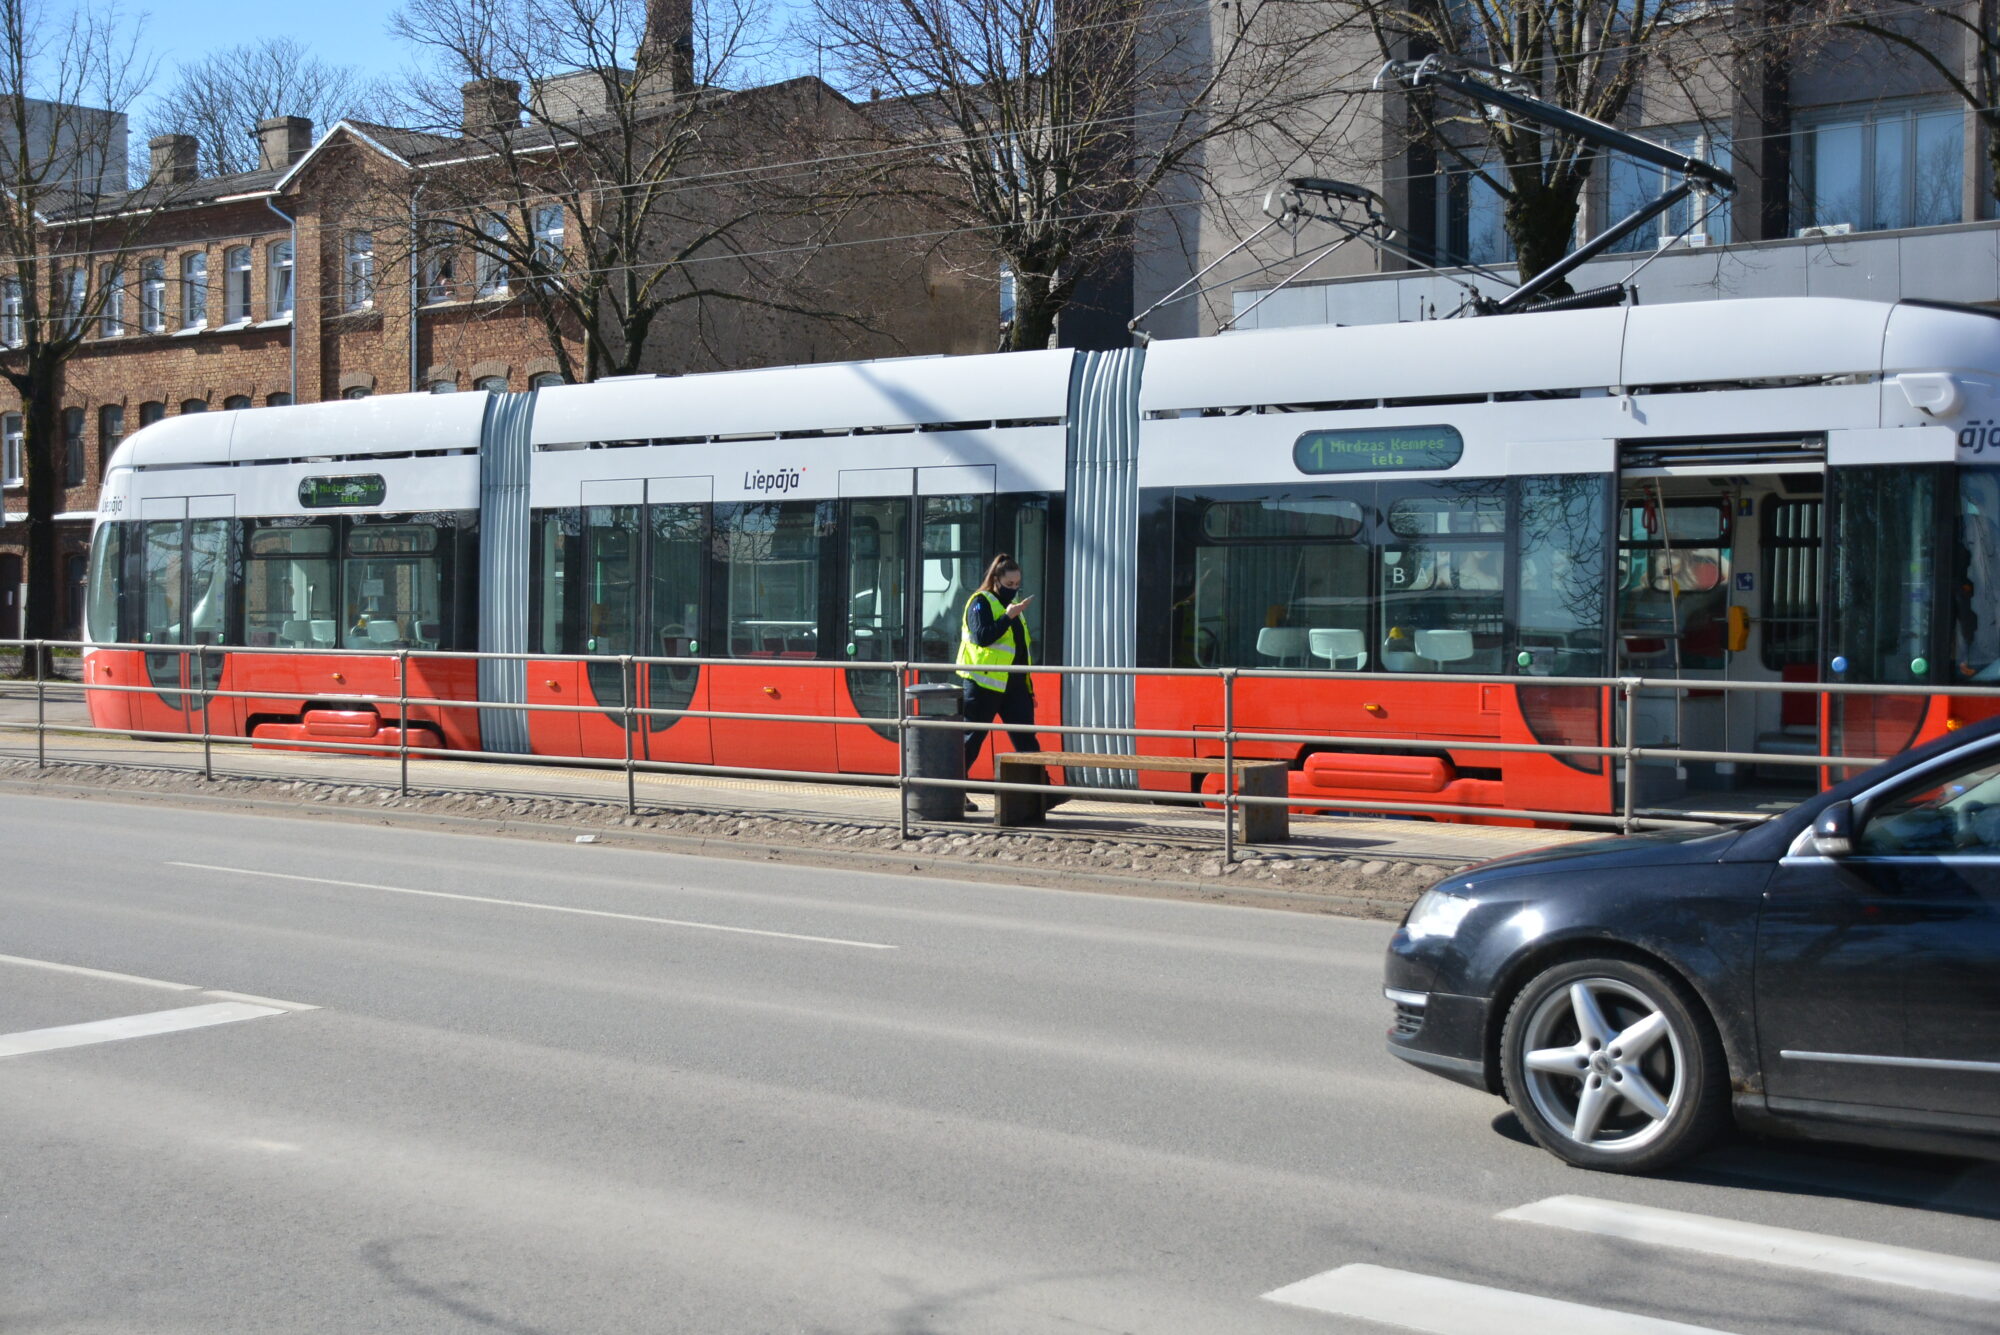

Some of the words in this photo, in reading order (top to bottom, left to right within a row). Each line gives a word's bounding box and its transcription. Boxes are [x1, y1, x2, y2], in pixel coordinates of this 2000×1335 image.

[1309, 438, 1324, 469] 1
[1330, 440, 1385, 453] Mirdzas
[1390, 437, 1445, 451] Kempes
[1371, 452, 1404, 465] iela
[743, 467, 800, 494] Liepāja
[1393, 567, 1406, 584] B
